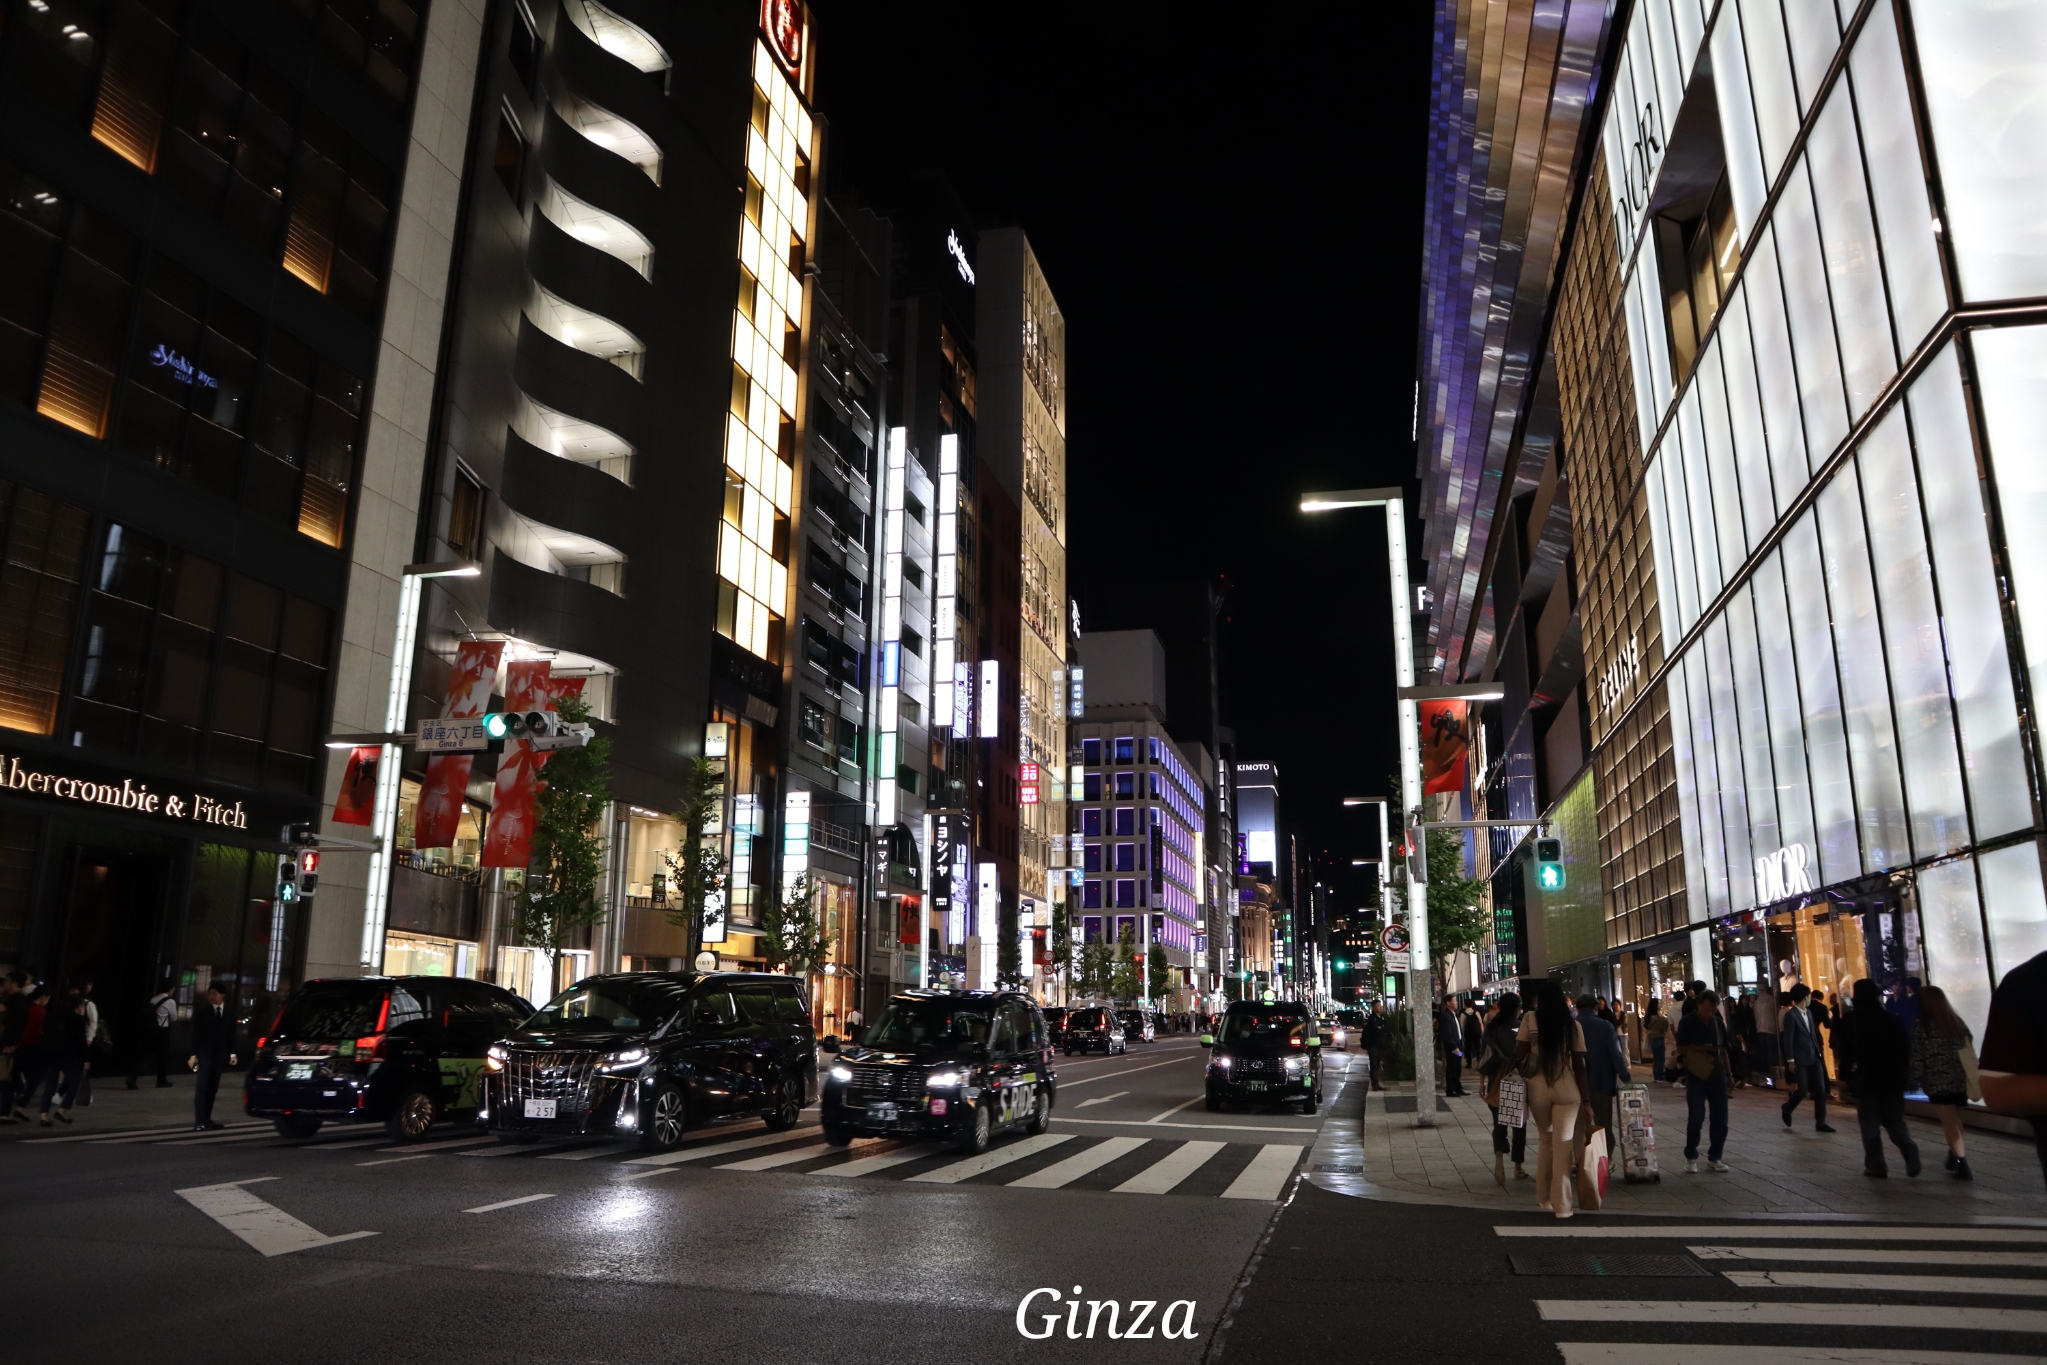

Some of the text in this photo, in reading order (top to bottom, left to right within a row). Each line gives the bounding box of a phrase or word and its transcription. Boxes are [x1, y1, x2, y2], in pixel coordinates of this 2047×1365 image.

[1614, 102, 1661, 264] DIOR
[422, 726, 483, 740] 銀座六丁目
[439, 740, 457, 748] Ginza
[0, 754, 248, 829] Abercrombie & Fitch
[877, 851, 888, 884] マギー
[937, 827, 948, 877] ヨシノヤ
[1755, 843, 1813, 905] DIOR
